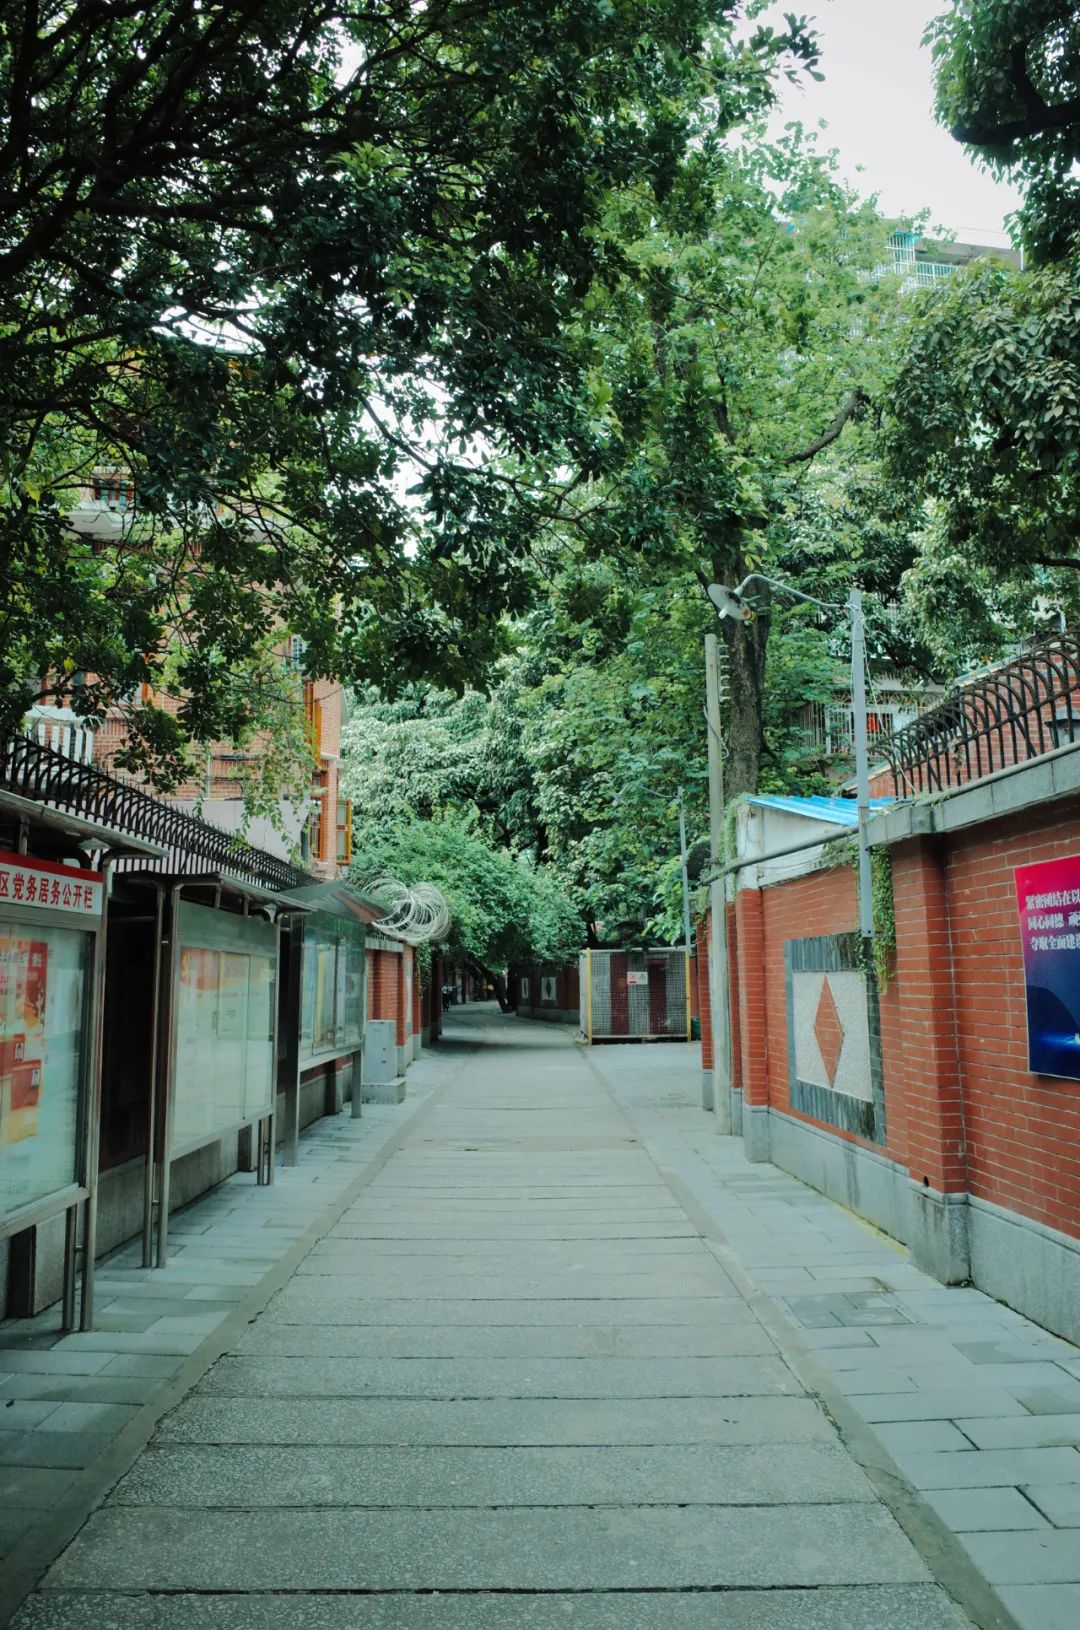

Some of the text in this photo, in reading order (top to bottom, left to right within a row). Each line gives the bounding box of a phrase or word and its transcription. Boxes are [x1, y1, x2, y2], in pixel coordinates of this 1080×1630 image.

[0, 869, 93, 910] 区党务居务公开栏
[1028, 912, 1064, 930] 同心同德
